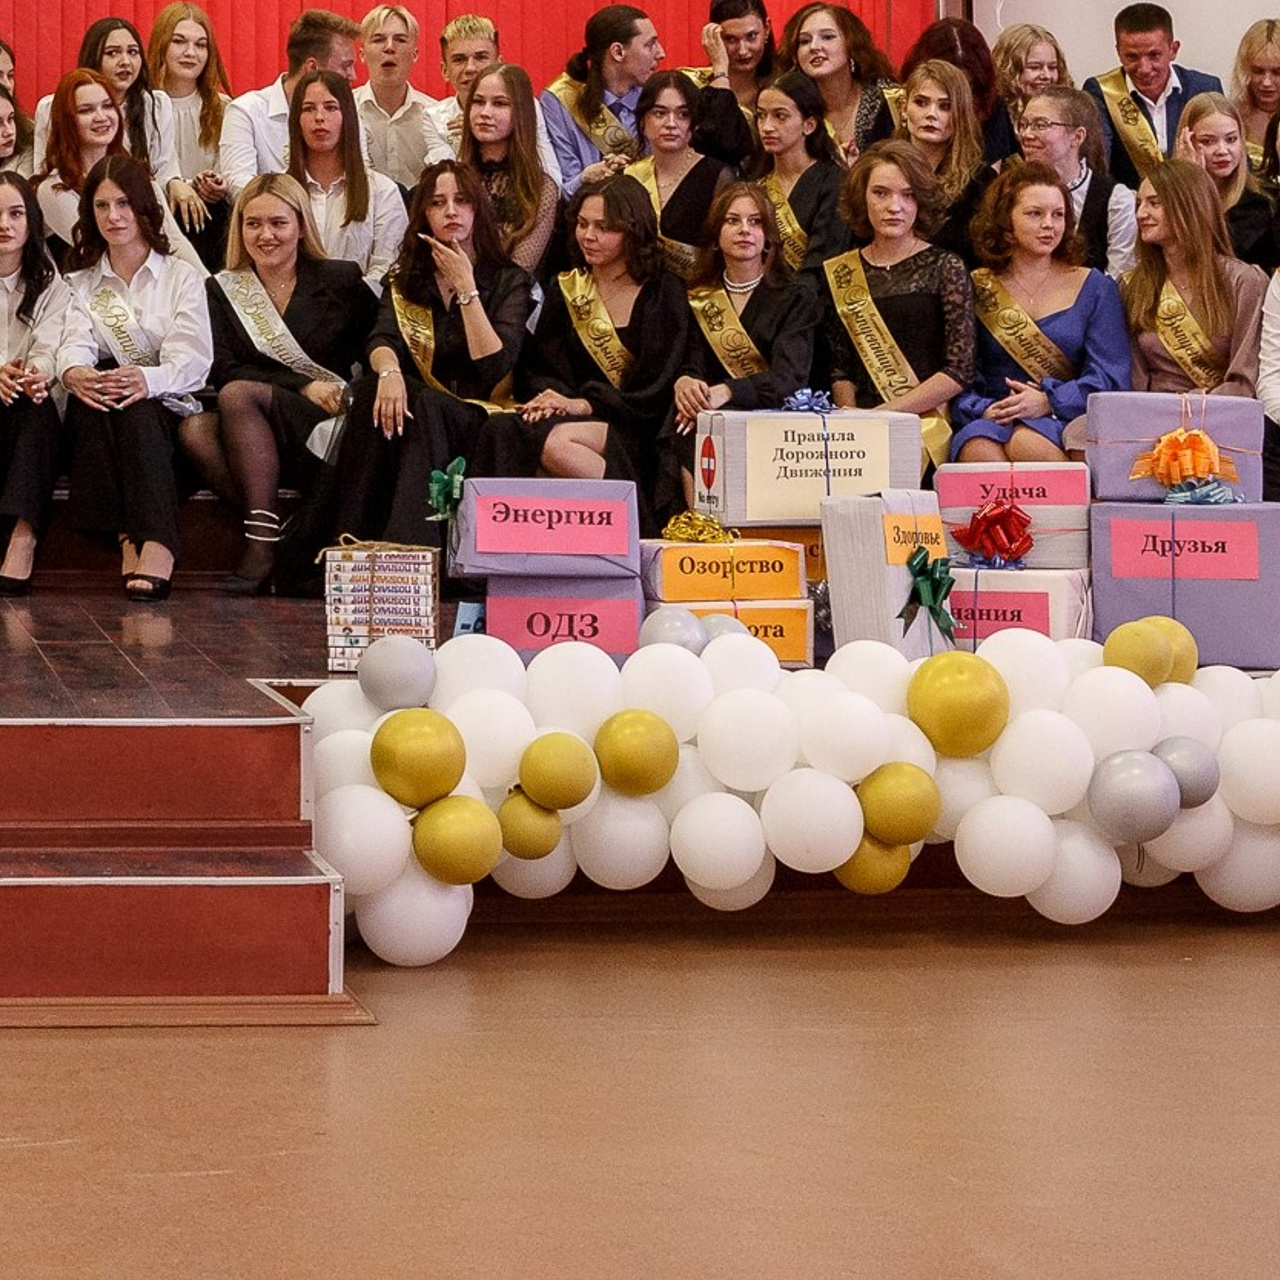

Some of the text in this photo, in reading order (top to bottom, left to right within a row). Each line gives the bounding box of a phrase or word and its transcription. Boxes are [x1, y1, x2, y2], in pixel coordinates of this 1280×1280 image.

[783, 429, 855, 446] Правила
[980, 483, 1048, 502] Удача
[491, 501, 613, 530] Энергия
[893, 525, 941, 549] Здоровье
[1141, 534, 1228, 558] Друзья
[679, 556, 784, 579] Озорство
[526, 612, 599, 641] ОДЗ
[951, 607, 1023, 623] нания
